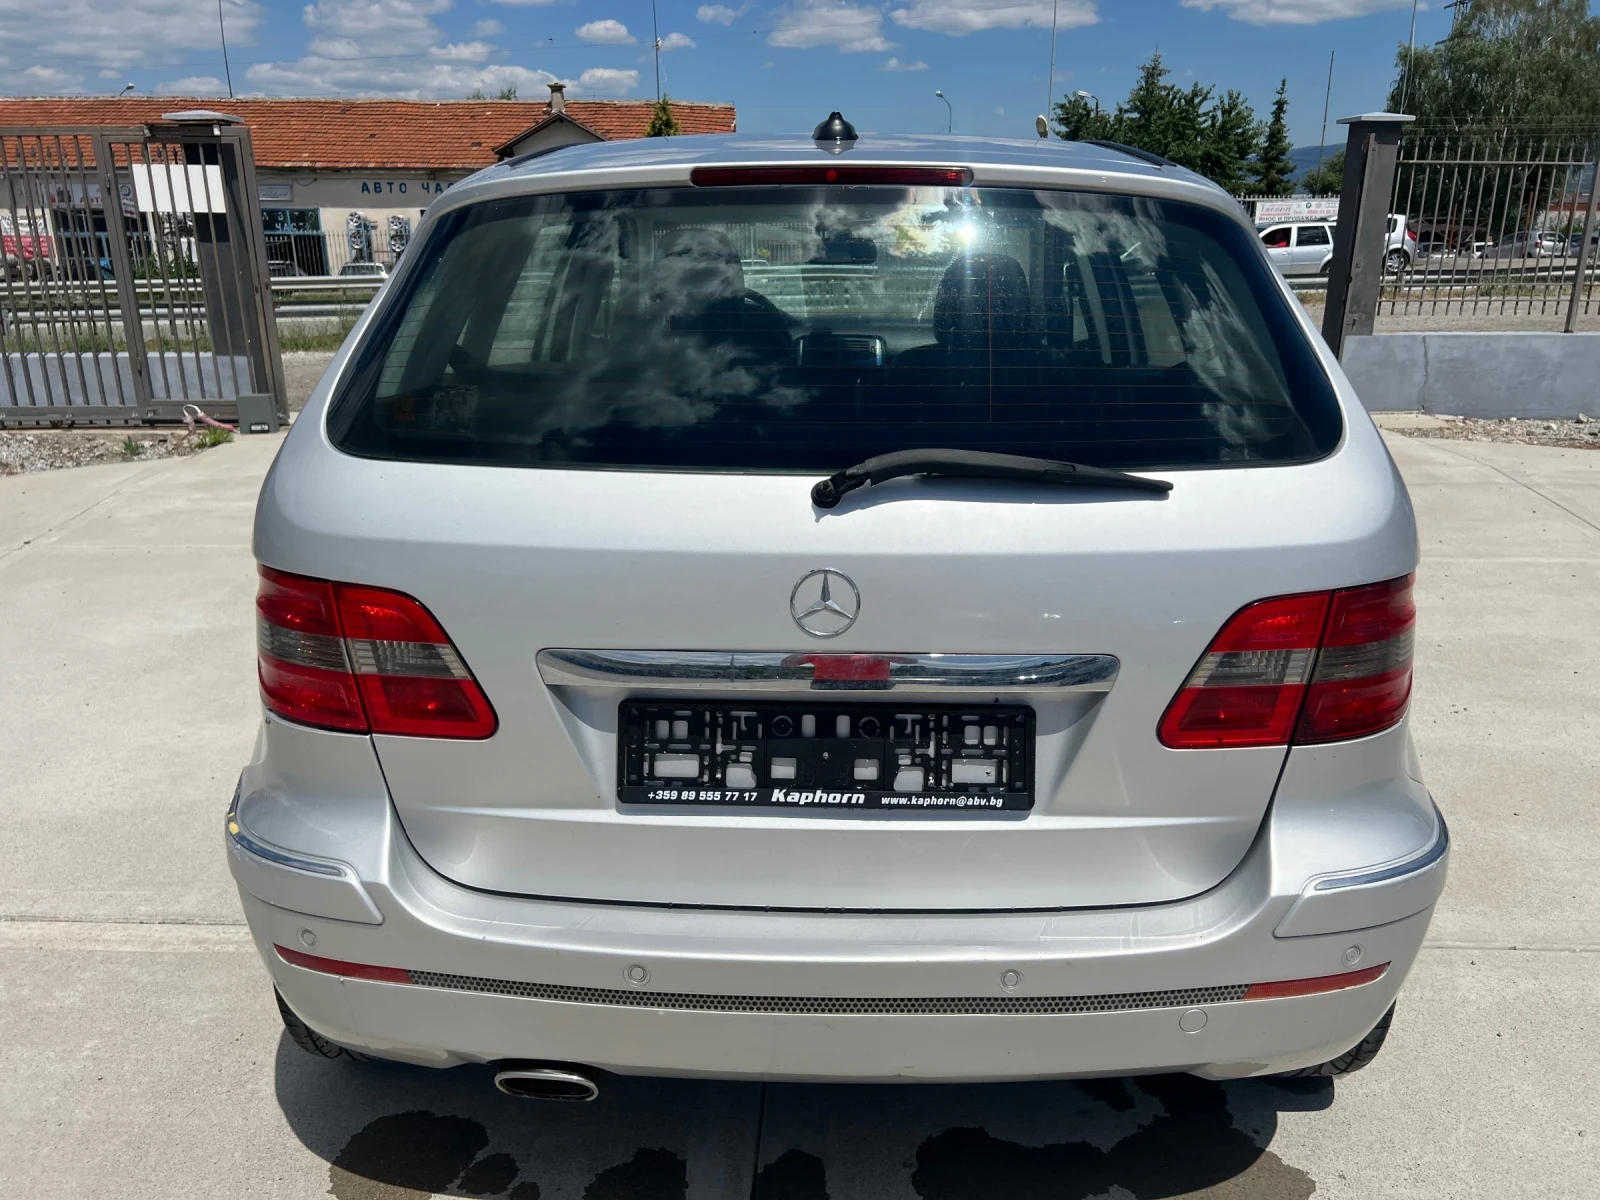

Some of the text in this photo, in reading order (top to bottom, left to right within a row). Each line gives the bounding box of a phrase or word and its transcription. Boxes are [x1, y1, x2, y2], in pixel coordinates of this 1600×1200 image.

[361, 181, 407, 195] АВТО
[647, 788, 1004, 808] +359 89 555 77 17 Kaphorn www.kaphorn@abv.bg
